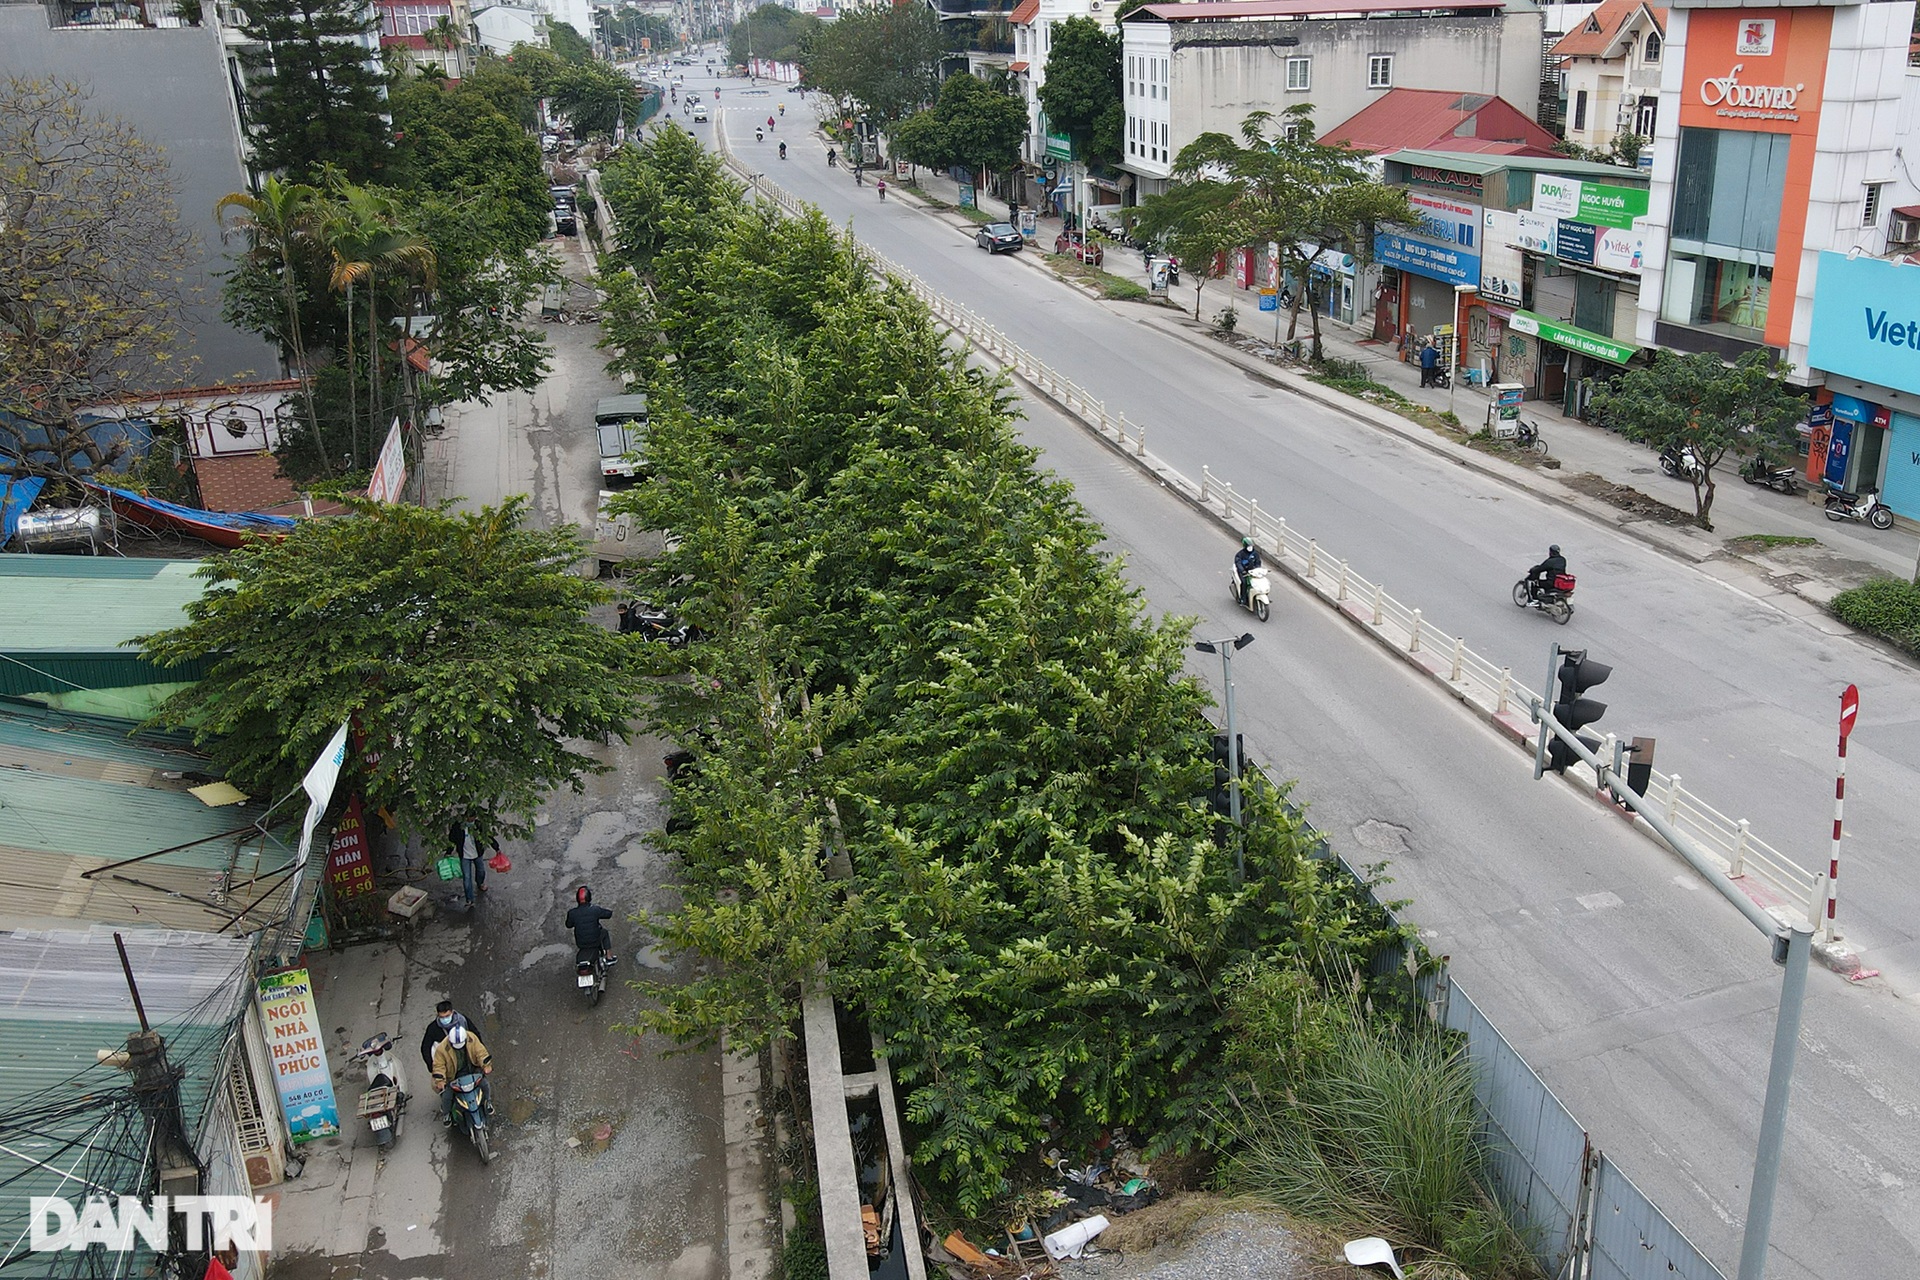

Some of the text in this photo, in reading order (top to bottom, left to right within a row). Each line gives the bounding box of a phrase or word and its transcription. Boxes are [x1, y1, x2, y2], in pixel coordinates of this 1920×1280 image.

[1700, 64, 1798, 110] FOREVER
[1581, 193, 1600, 206] NGỌC
[1874, 416, 1887, 425] ATM
[332, 834, 359, 851] SƠN
[335, 850, 362, 867] HÀN
[333, 865, 370, 883] XE GA
[336, 876, 373, 898] XE SỐ
[267, 998, 308, 1021] NGÔI
[273, 1016, 309, 1039] NHÀ
[272, 1036, 318, 1059] HẠNH
[278, 1054, 320, 1076] PHÚC
